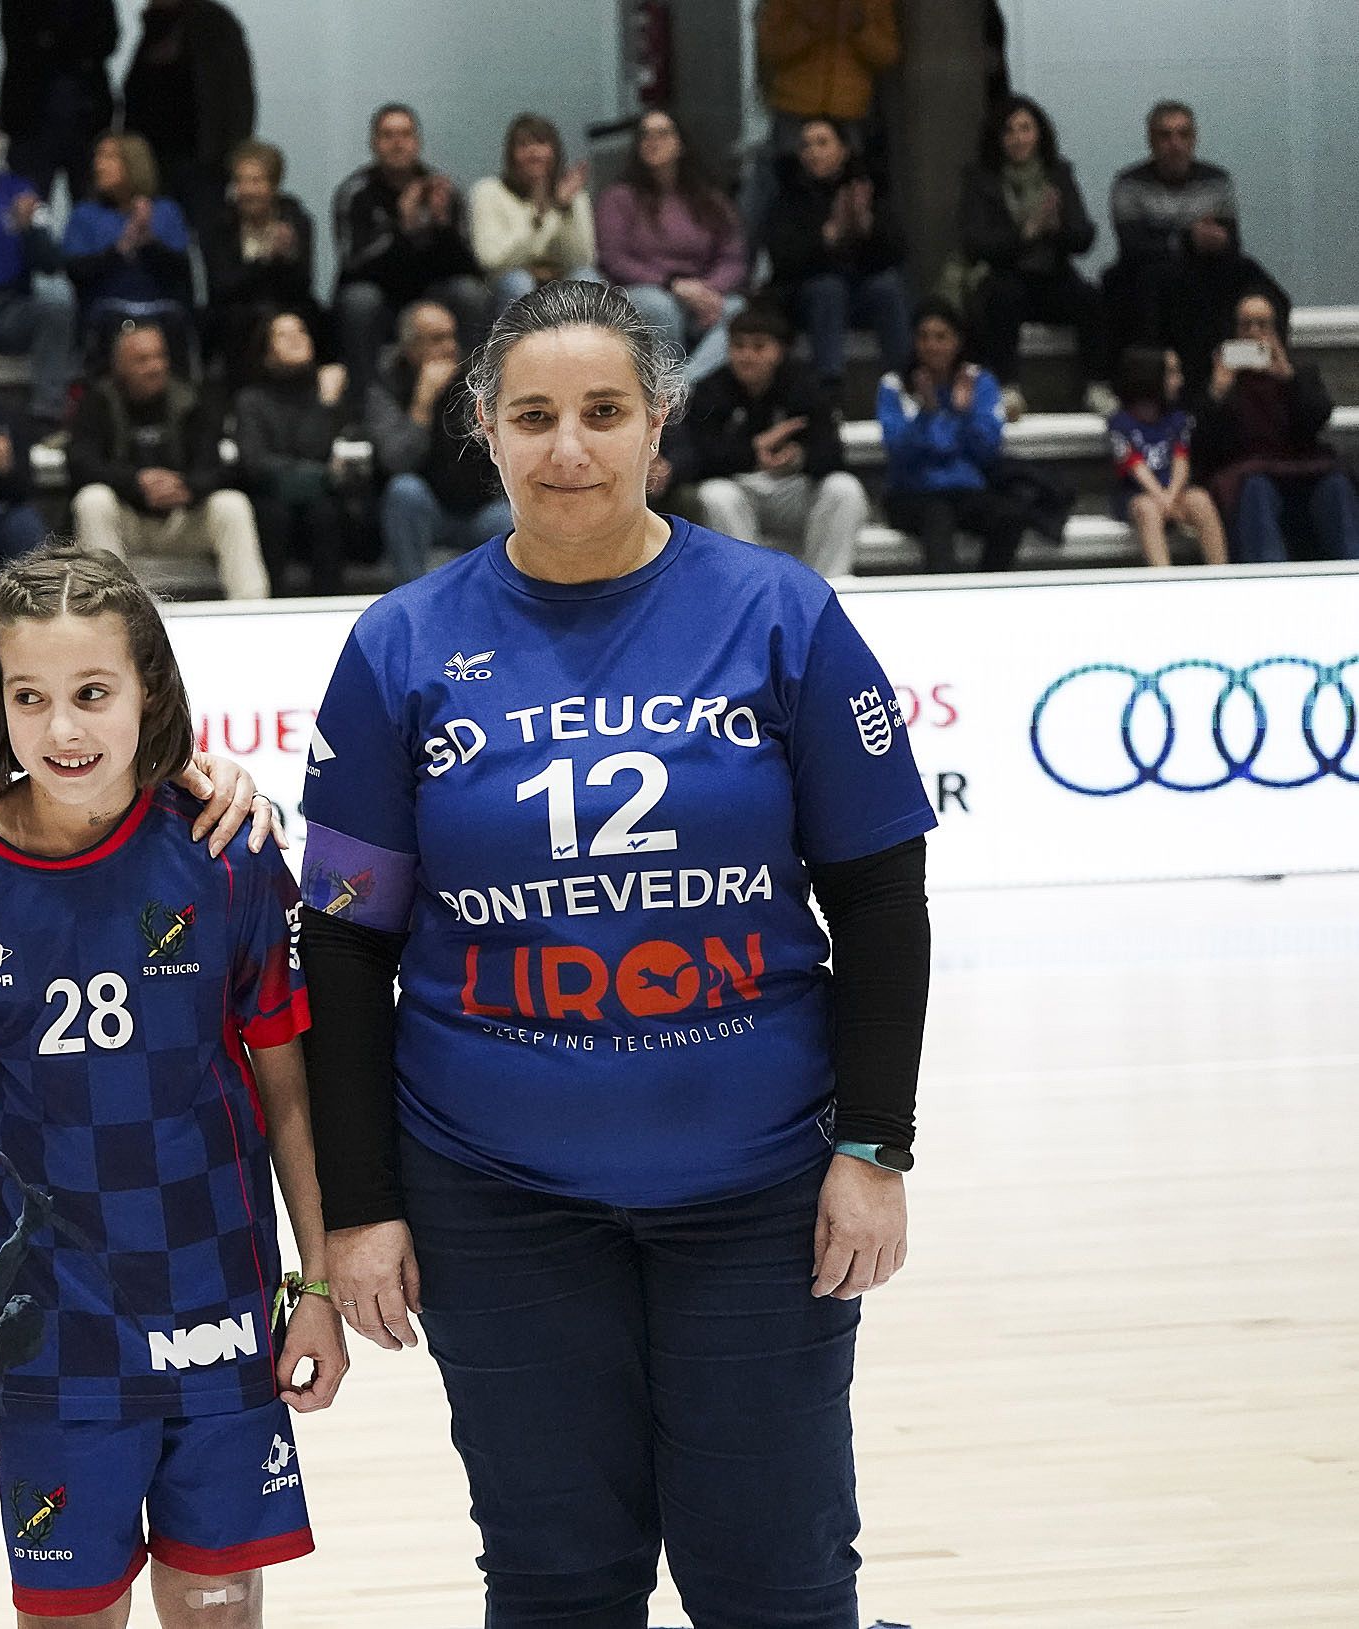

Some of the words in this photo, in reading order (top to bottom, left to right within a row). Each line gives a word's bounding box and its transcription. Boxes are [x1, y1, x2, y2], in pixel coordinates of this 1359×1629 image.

[425, 719, 486, 777] SD
[506, 695, 761, 749] TEUCRO
[515, 752, 678, 861] 12
[438, 863, 772, 925] PONTEVEDRA
[142, 966, 158, 976] SD
[159, 962, 200, 975] TEUCRO
[461, 932, 764, 1020] LIRON
[38, 972, 134, 1054] 28
[612, 1015, 756, 1052] TECHNOLOGY
[148, 1312, 258, 1371] NON
[13, 1546, 25, 1559] SD
[26, 1549, 73, 1561] TEUCRO
